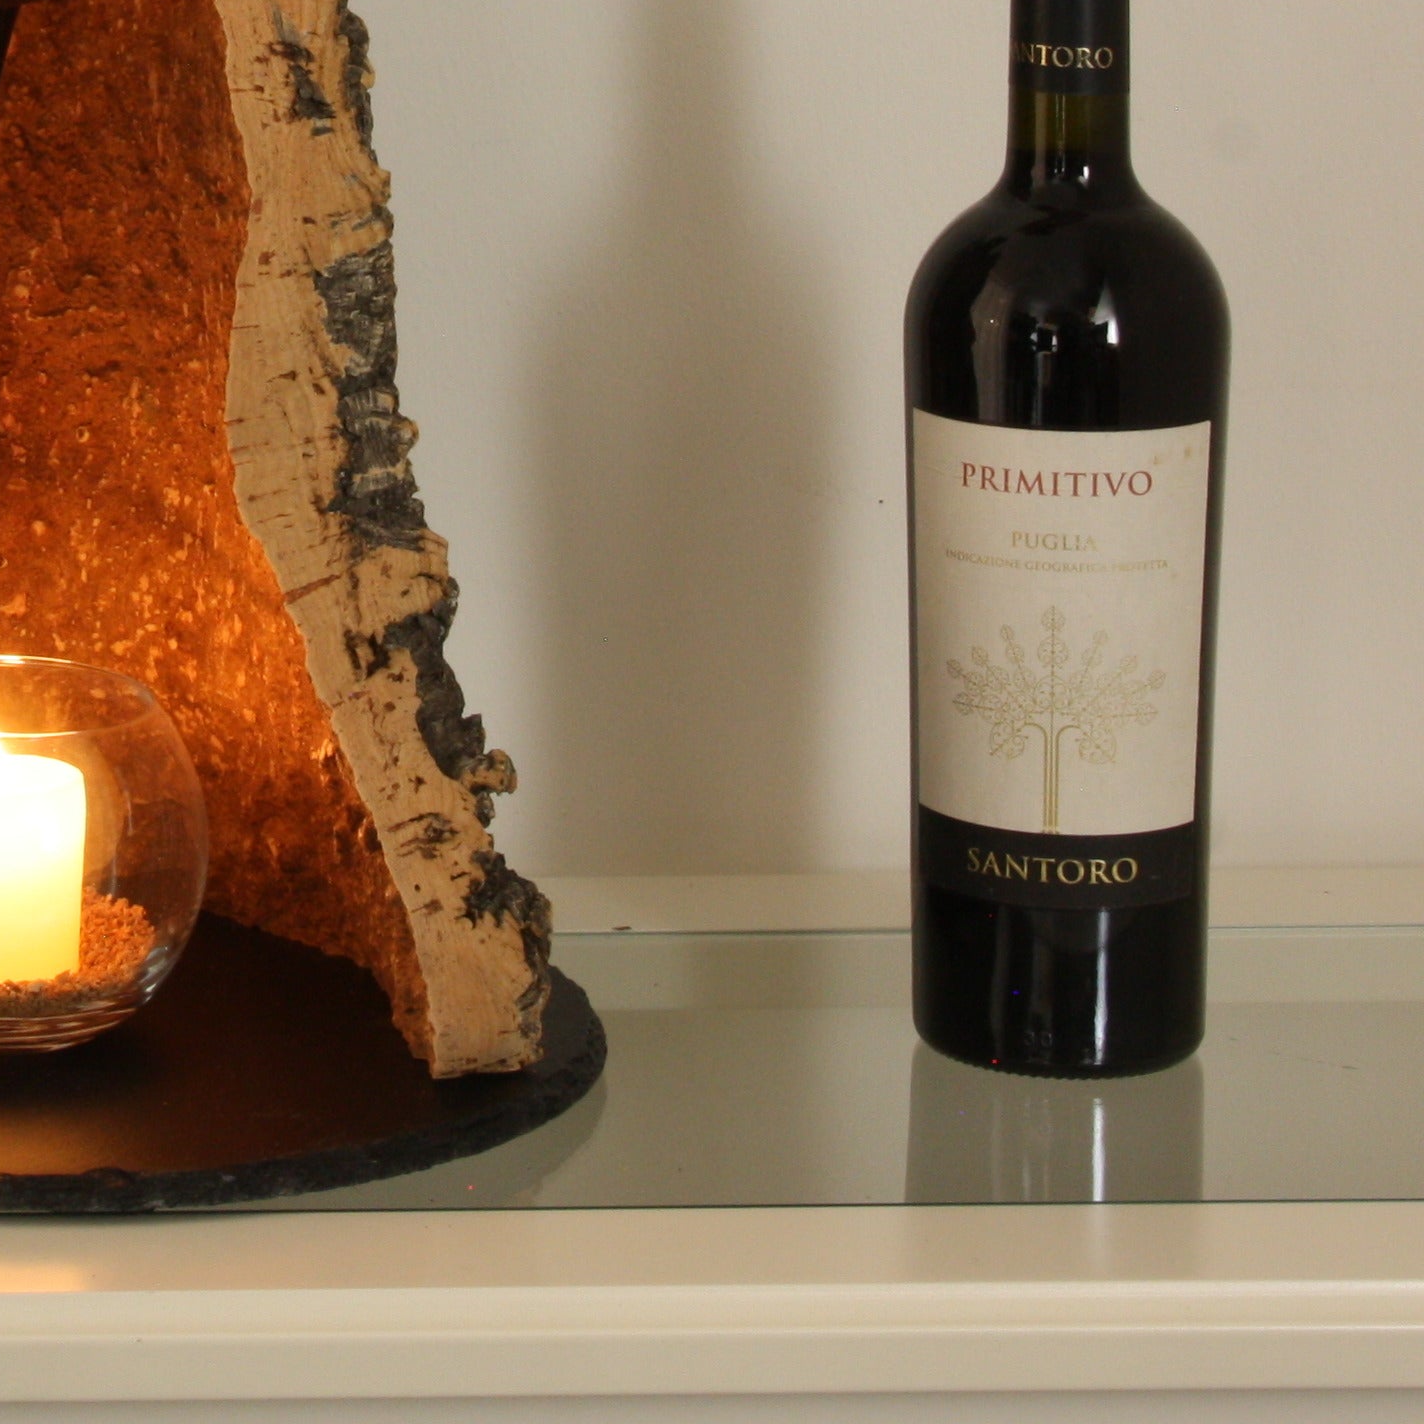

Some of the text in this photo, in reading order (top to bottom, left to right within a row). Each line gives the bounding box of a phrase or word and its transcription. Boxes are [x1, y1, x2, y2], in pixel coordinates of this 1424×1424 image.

[961, 462, 1153, 497] PRIMITIVO
[1011, 531, 1098, 552] PUGLIA
[967, 846, 1138, 885] SANTORO
